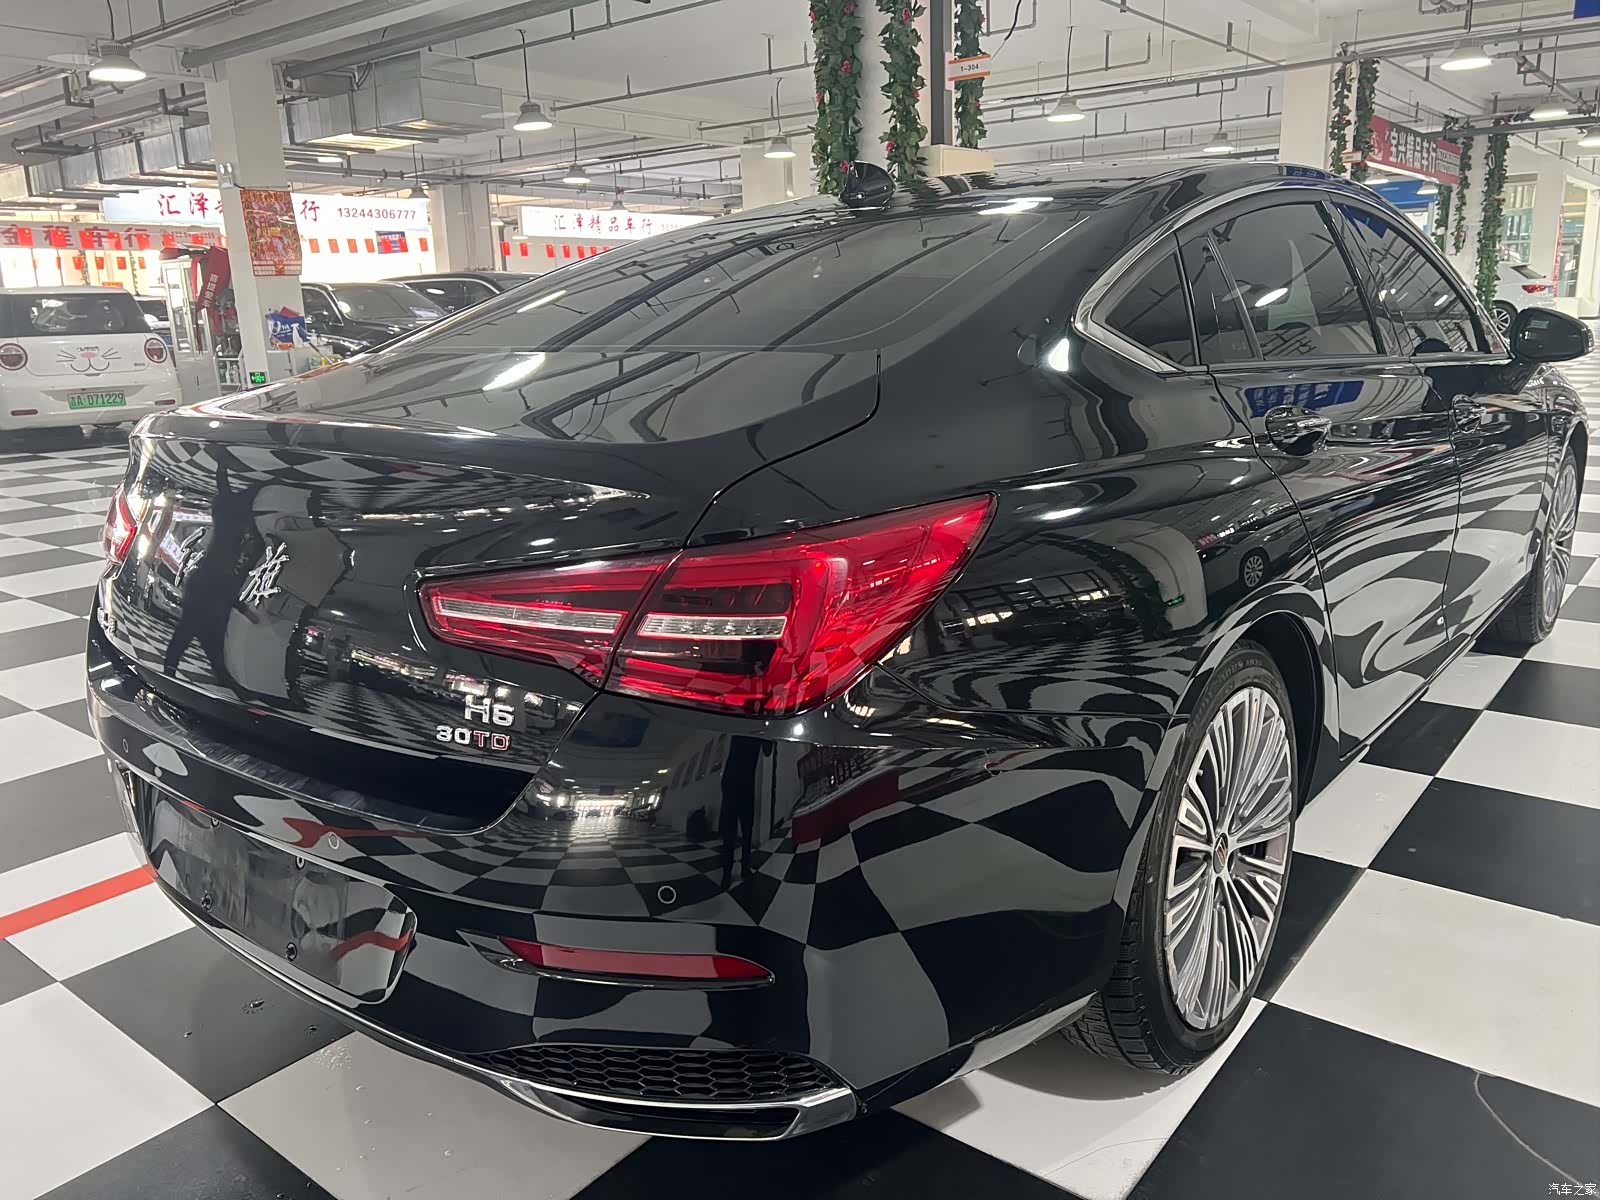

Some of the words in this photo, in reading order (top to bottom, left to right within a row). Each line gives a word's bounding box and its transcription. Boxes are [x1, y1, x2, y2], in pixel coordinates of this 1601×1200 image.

[960, 63, 979, 72] 1-304
[1389, 127, 1437, 174] 宝兴精品车行
[337, 207, 416, 220] 13244306777
[553, 213, 653, 234] 汇泽精品车行
[436, 725, 510, 751] 30TD
